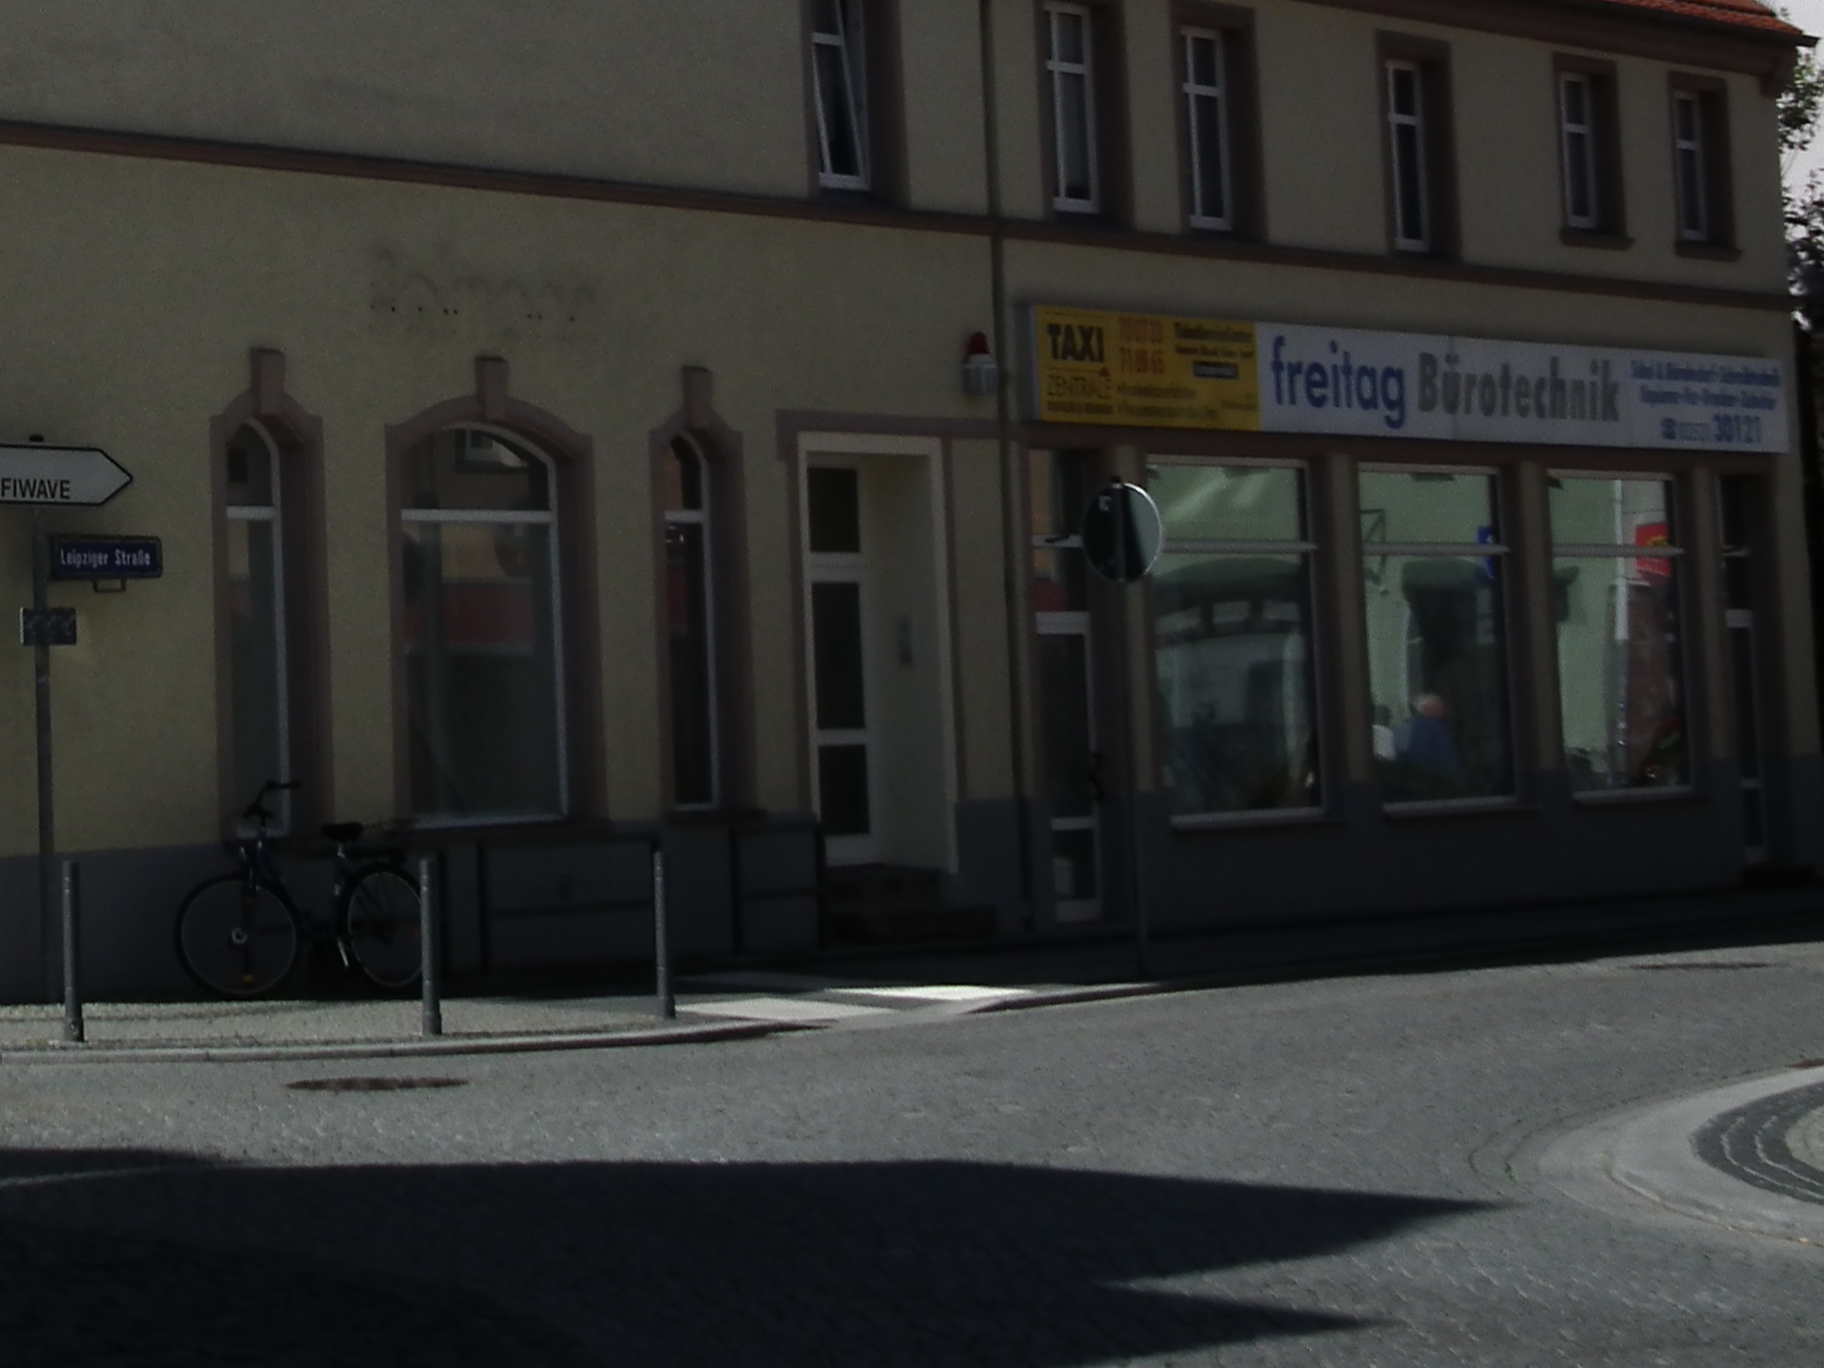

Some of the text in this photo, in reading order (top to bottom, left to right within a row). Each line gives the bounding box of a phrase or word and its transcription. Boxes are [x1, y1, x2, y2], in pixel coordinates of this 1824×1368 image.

[1047, 323, 1104, 362] TAXI
[1047, 375, 1112, 399] ZENTRALE
[1271, 335, 1619, 429] freitag Bürotechnik
[1, 477, 70, 499] FIWAVE
[60, 549, 151, 567] Leipziger Straße
